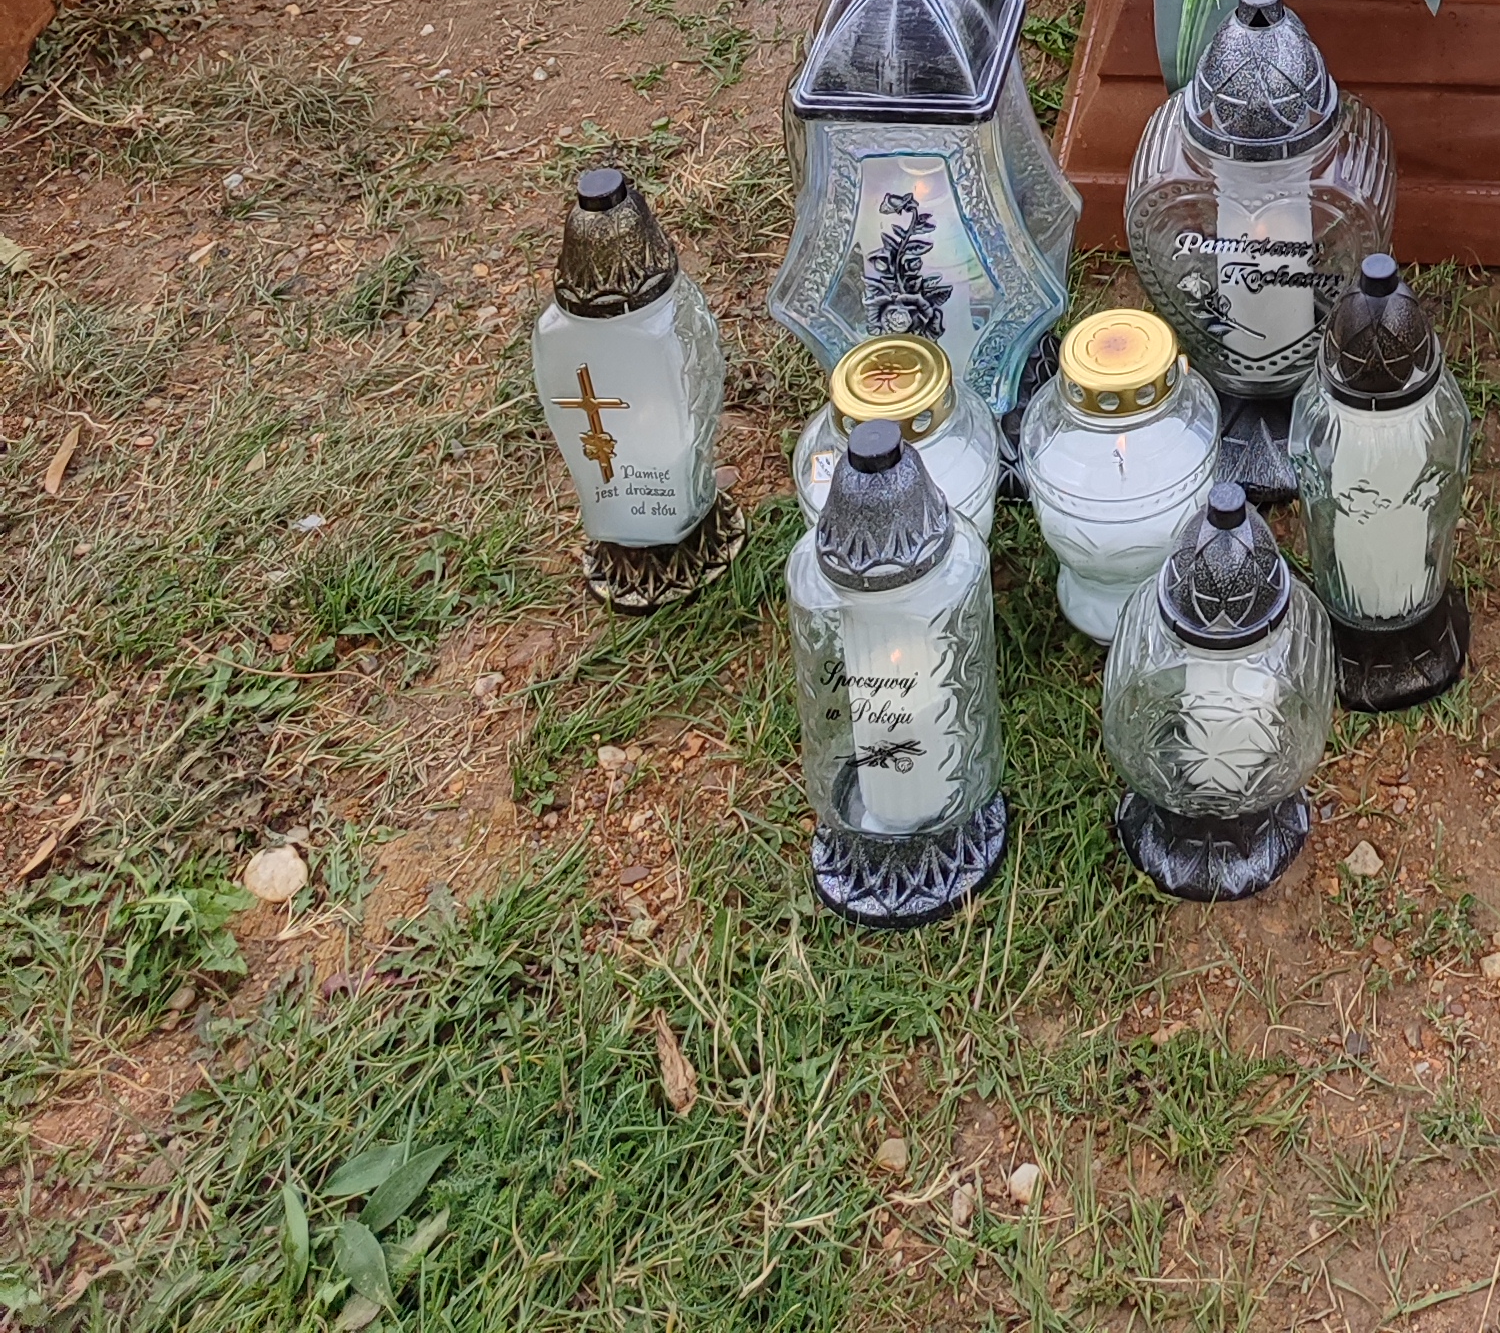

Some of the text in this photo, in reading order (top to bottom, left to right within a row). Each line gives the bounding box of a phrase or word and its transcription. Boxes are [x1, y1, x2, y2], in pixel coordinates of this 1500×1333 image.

[620, 464, 670, 483] Pamięć
[595, 486, 619, 503] jest
[630, 501, 646, 515] od
[820, 660, 918, 699] Spoczywaj
[849, 697, 914, 733] Pokoju
